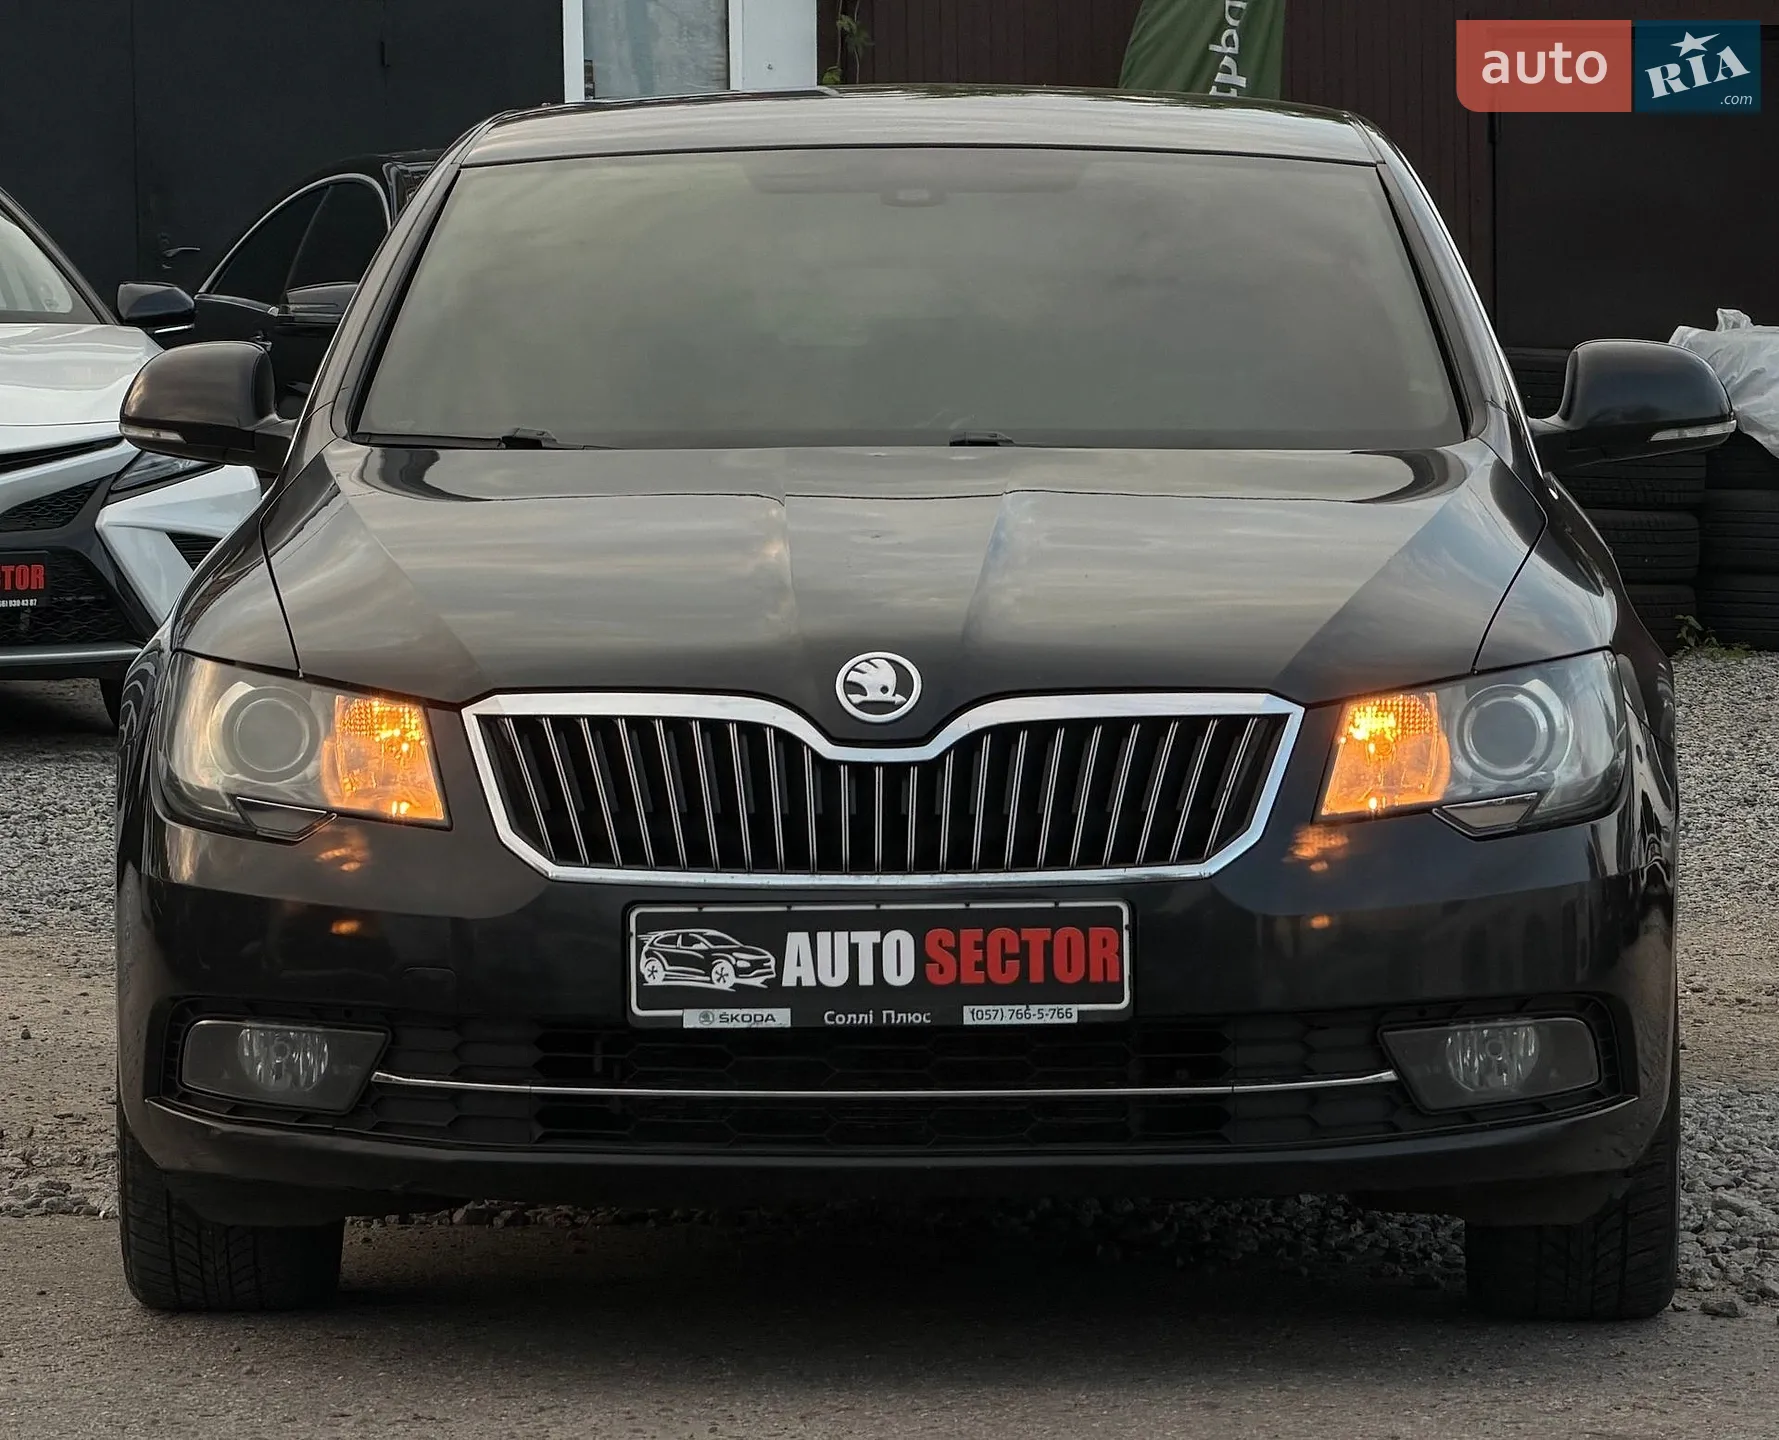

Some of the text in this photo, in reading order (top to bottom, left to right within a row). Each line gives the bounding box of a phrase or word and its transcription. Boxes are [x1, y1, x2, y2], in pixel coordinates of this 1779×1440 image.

[782, 927, 1121, 988] AUTO SECTOR
[719, 1012, 776, 1023] ŠKODA
[824, 1009, 932, 1025] Соллі Плюс
[971, 1007, 1074, 1022] (057) 766-5-766
